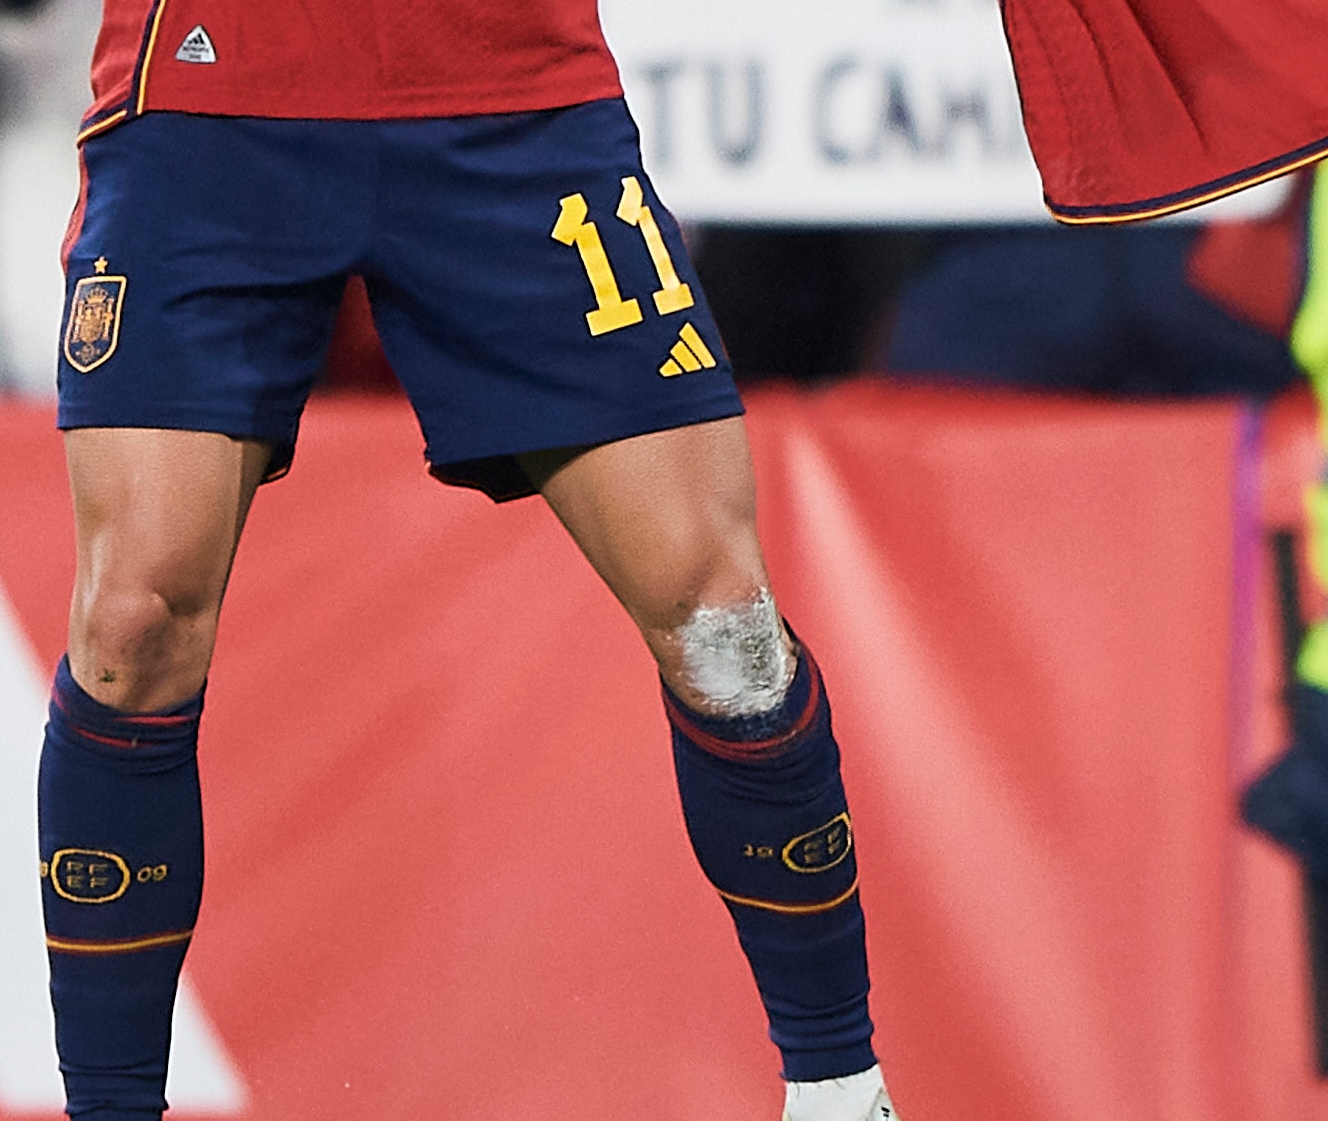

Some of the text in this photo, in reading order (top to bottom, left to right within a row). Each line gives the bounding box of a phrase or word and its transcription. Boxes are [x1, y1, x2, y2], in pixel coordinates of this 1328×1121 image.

[633, 56, 1016, 168] TU CAM
[551, 176, 694, 336] 11
[137, 863, 168, 883] 09
